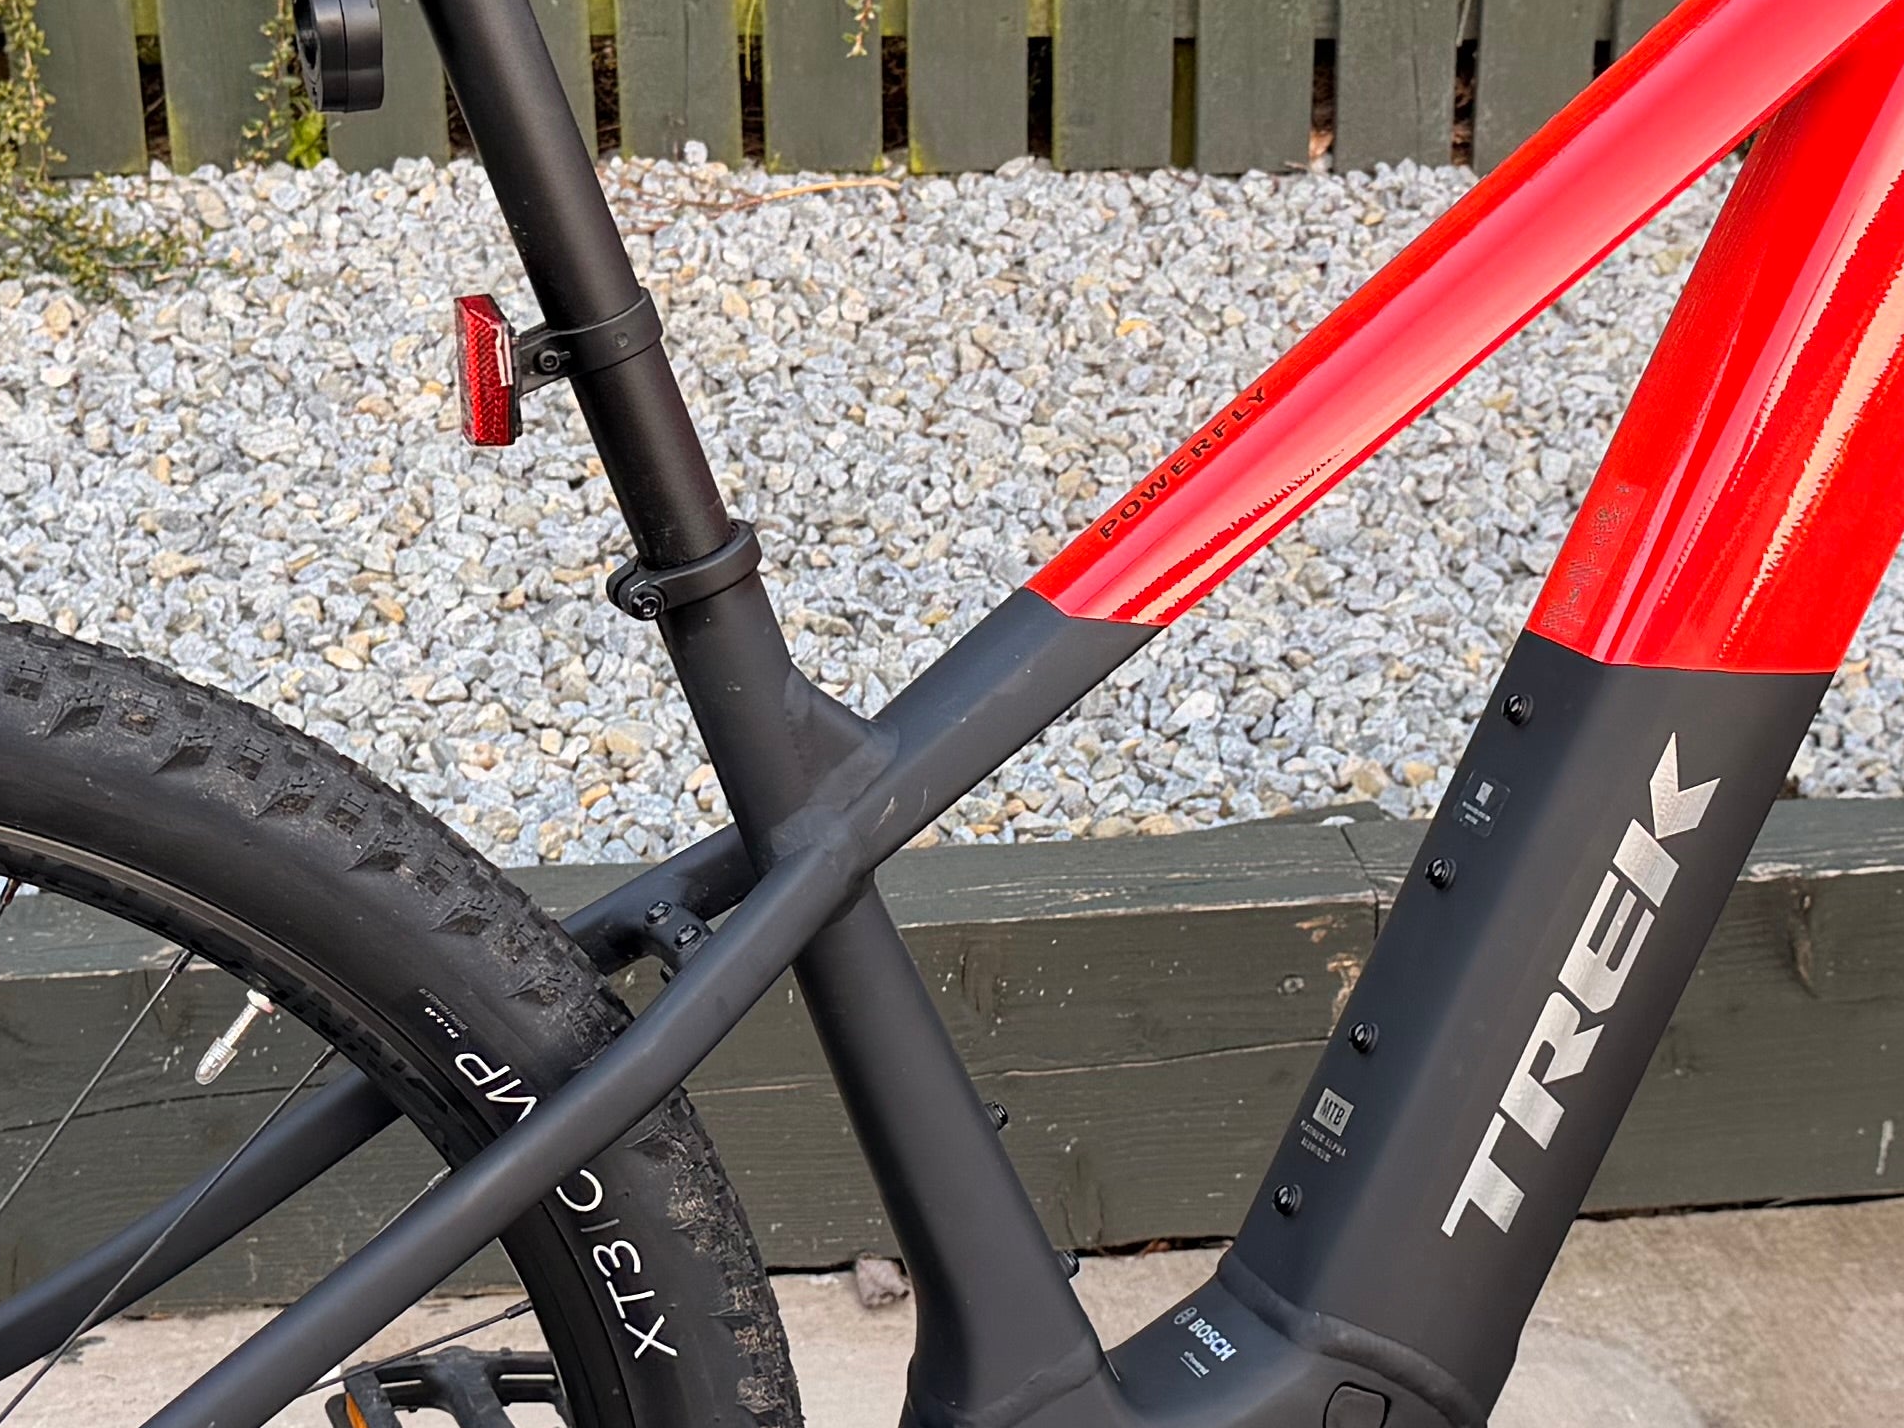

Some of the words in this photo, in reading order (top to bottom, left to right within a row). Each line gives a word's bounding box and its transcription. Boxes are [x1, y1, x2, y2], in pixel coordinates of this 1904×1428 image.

[1099, 386, 1268, 540] POWERFLY
[1441, 731, 1721, 1237] TREK
[1320, 1097, 1346, 1125] MTB
[593, 1239, 679, 1360] XT3
[1188, 1317, 1237, 1362] BOSCH
